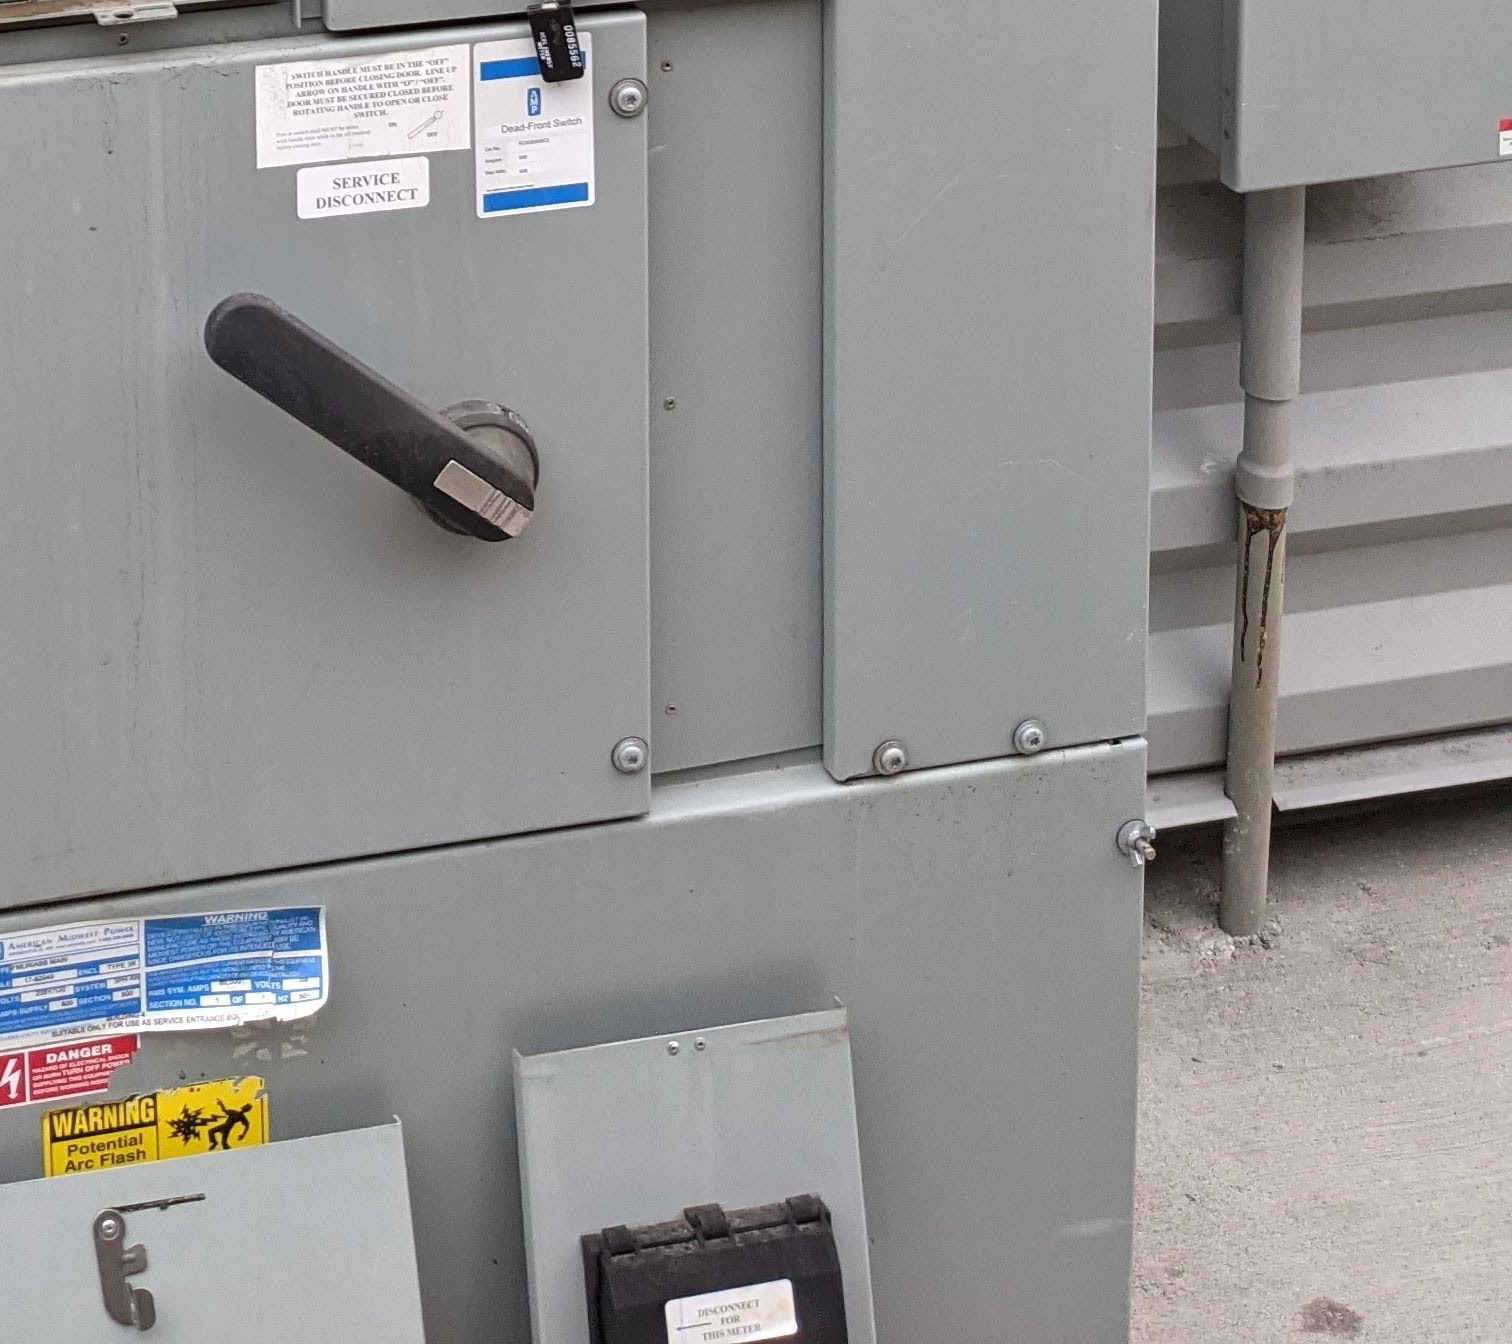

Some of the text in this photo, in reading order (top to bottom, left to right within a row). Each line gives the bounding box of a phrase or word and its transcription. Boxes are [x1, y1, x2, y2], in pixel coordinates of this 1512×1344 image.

[286, 78, 324, 90] POSITION
[325, 75, 357, 87] BEFORE
[358, 72, 395, 84] CLOSING
[425, 67, 445, 76] LINE
[446, 65, 457, 74] UP
[291, 70, 324, 81] SWITCH
[325, 66, 358, 78] HANDLE
[359, 64, 383, 75] MUST
[383, 63, 395, 72] BE
[396, 62, 406, 71] IN
[407, 60, 423, 70] THE
[286, 84, 453, 109] DOOR MUST BE SECURED CLOSED BEFORE
[295, 87, 326, 98] ARROW
[327, 86, 340, 96] ON
[341, 83, 375, 95] HANDLE
[375, 80, 399, 91] WITH
[292, 93, 449, 117] ROTATING HANDLE TO OPEN OR CLOSE
[530, 90, 539, 114] AMP
[501, 117, 583, 134] Dead-Front Switch
[332, 172, 401, 190] SERVICE
[315, 187, 418, 210] DISCONNECT
[204, 912, 268, 925] WARNING
[187, 983, 210, 993] AMPS
[254, 980, 281, 991] VOLTS
[148, 999, 183, 1009] SECTION
[231, 996, 243, 1004] OF
[51, 1026, 86, 1037] SUITABLE
[86, 1023, 107, 1033] ONLY
[107, 1021, 124, 1030] FOR
[124, 1019, 141, 1028] USE
[141, 1018, 152, 1026] AS
[153, 1016, 184, 1026] SERVICE
[185, 1014, 225, 1024] ENTRANCE
[45, 1043, 112, 1064] DANGER
[62, 1067, 83, 1076] TURN
[84, 1064, 101, 1072] OFF
[52, 1097, 155, 1138] WARNING
[67, 1132, 143, 1158] Potential
[64, 1148, 147, 1173] Arc Flash
[697, 1298, 760, 1318] DISCONNECT
[720, 1314, 741, 1326] FOR
[703, 1323, 761, 1341] THIS METER
